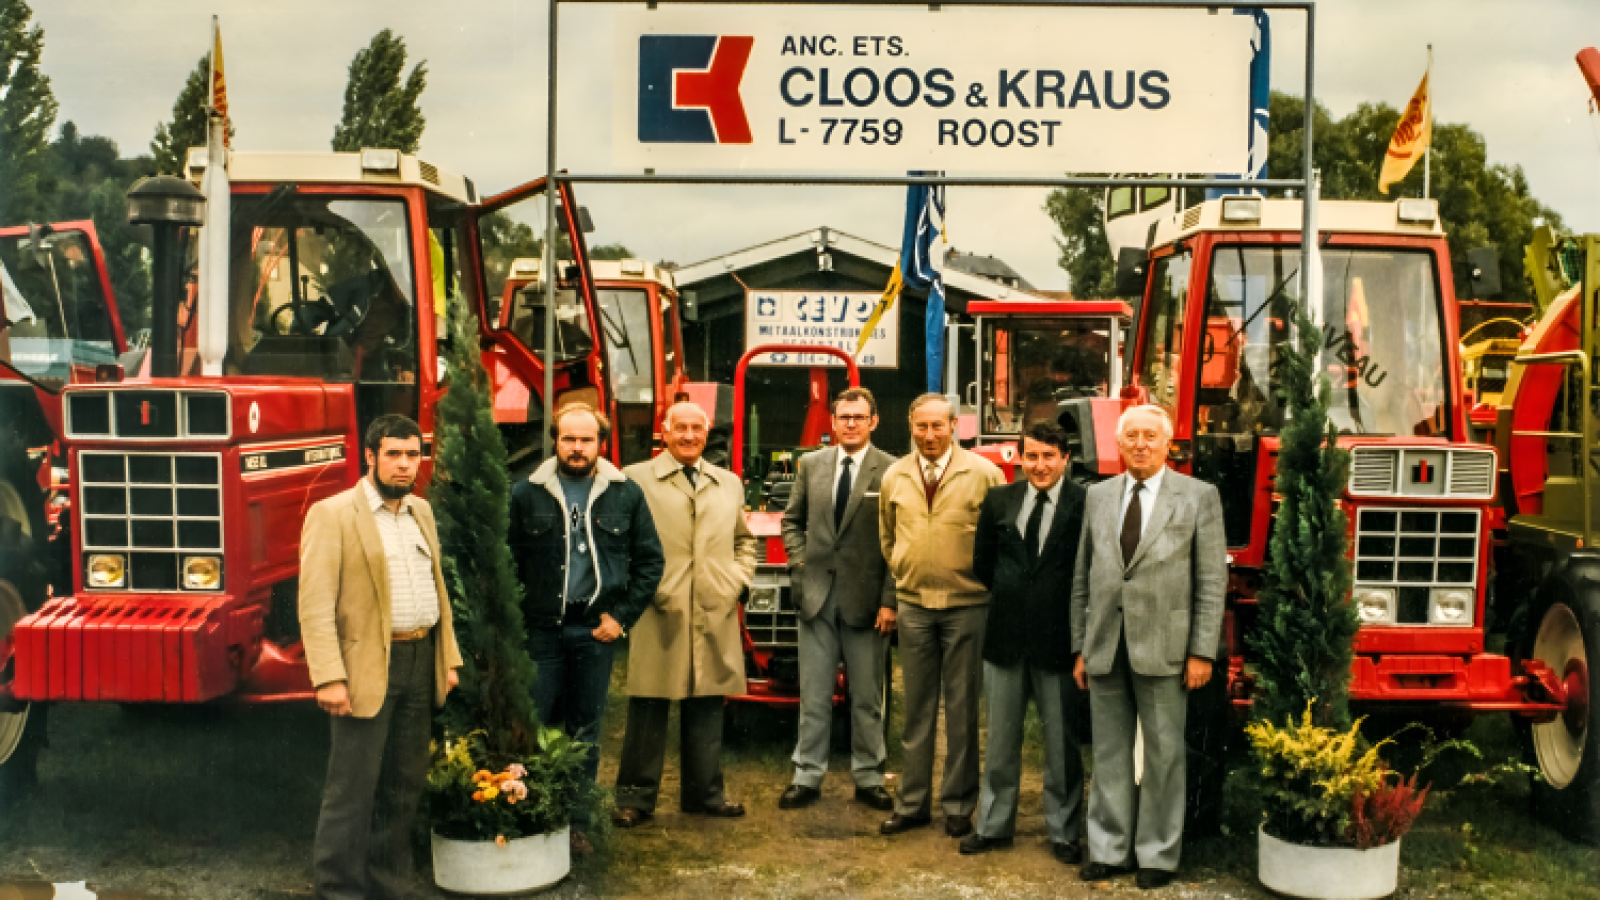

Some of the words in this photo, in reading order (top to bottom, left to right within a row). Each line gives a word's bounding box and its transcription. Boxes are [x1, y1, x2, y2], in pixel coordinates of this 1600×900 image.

[780, 35, 843, 56] ANC.
[852, 35, 910, 57] ETS.
[779, 66, 956, 108] CLOOS
[965, 82, 989, 108] &
[998, 69, 1170, 110] KRAUS
[820, 118, 904, 146] 7759
[938, 118, 1063, 148] ROOST
